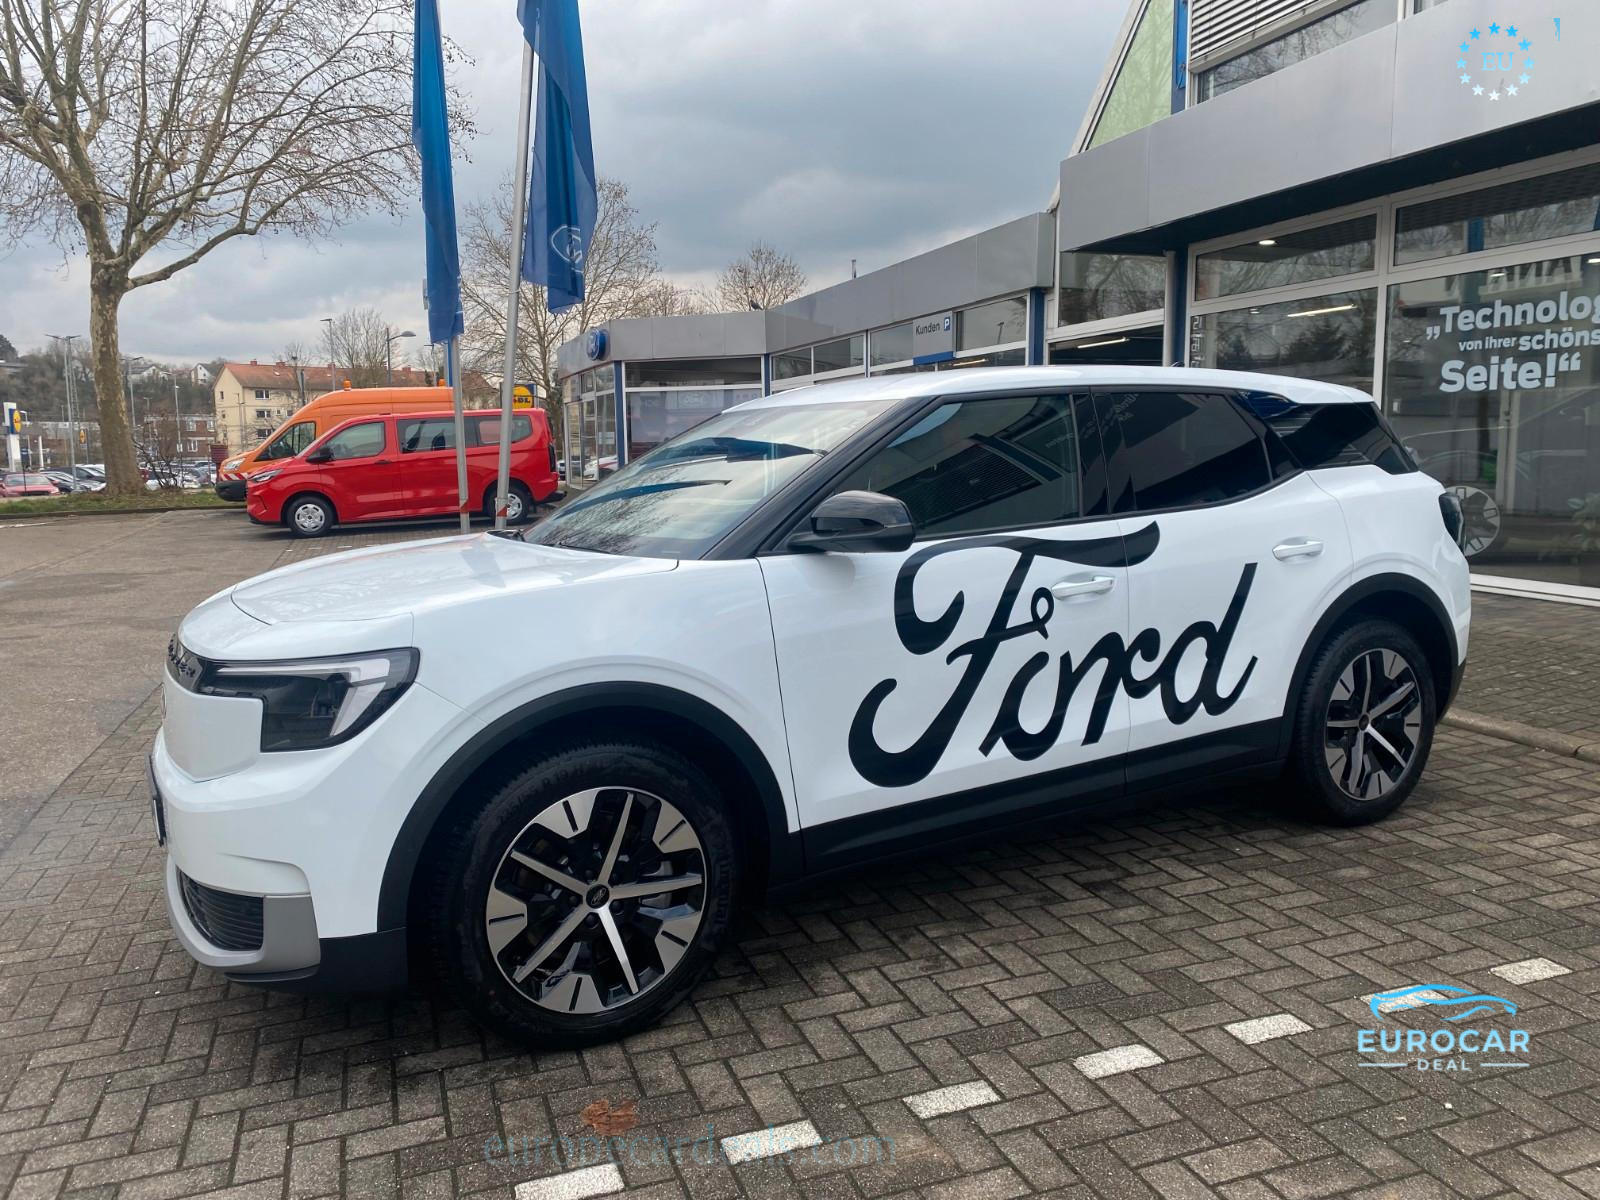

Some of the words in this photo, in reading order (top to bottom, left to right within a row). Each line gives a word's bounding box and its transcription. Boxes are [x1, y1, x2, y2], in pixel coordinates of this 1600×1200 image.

[915, 322, 940, 335] Kunden
[1458, 340, 1482, 352] von
[848, 520, 1258, 788] Ford
